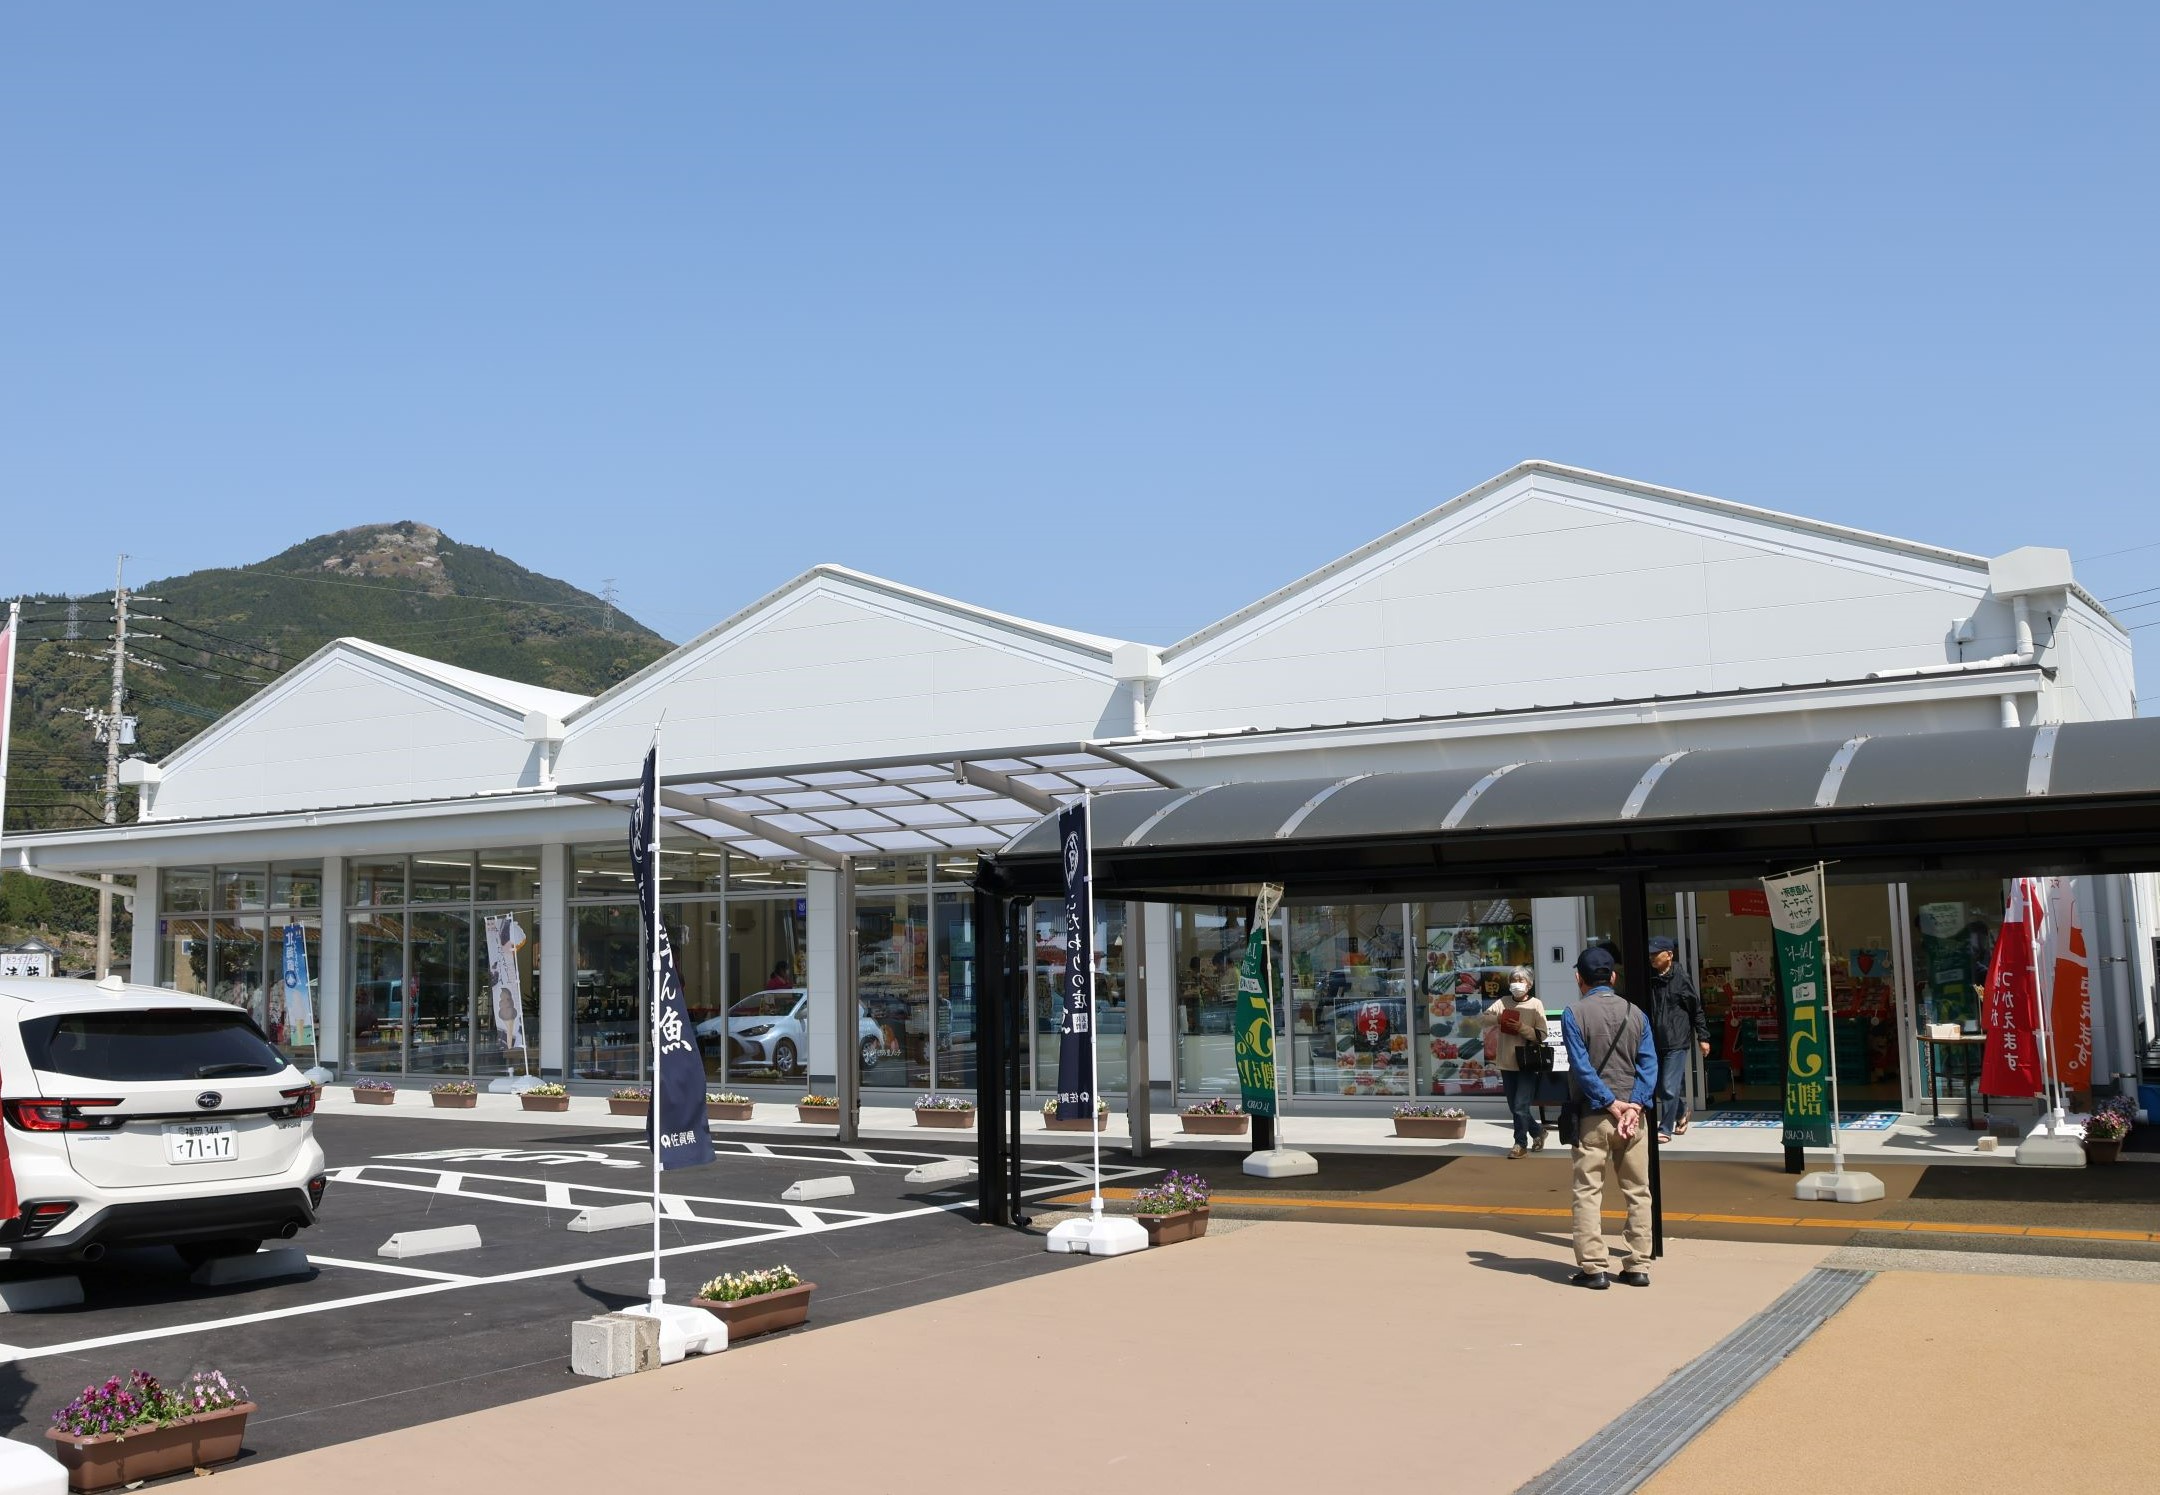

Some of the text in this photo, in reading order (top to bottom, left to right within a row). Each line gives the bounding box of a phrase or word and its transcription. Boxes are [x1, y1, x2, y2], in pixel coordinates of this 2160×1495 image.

[204, 1126, 219, 1136] 344
[671, 1130, 697, 1147] 佐賀県
[185, 1137, 230, 1158] 71-17
